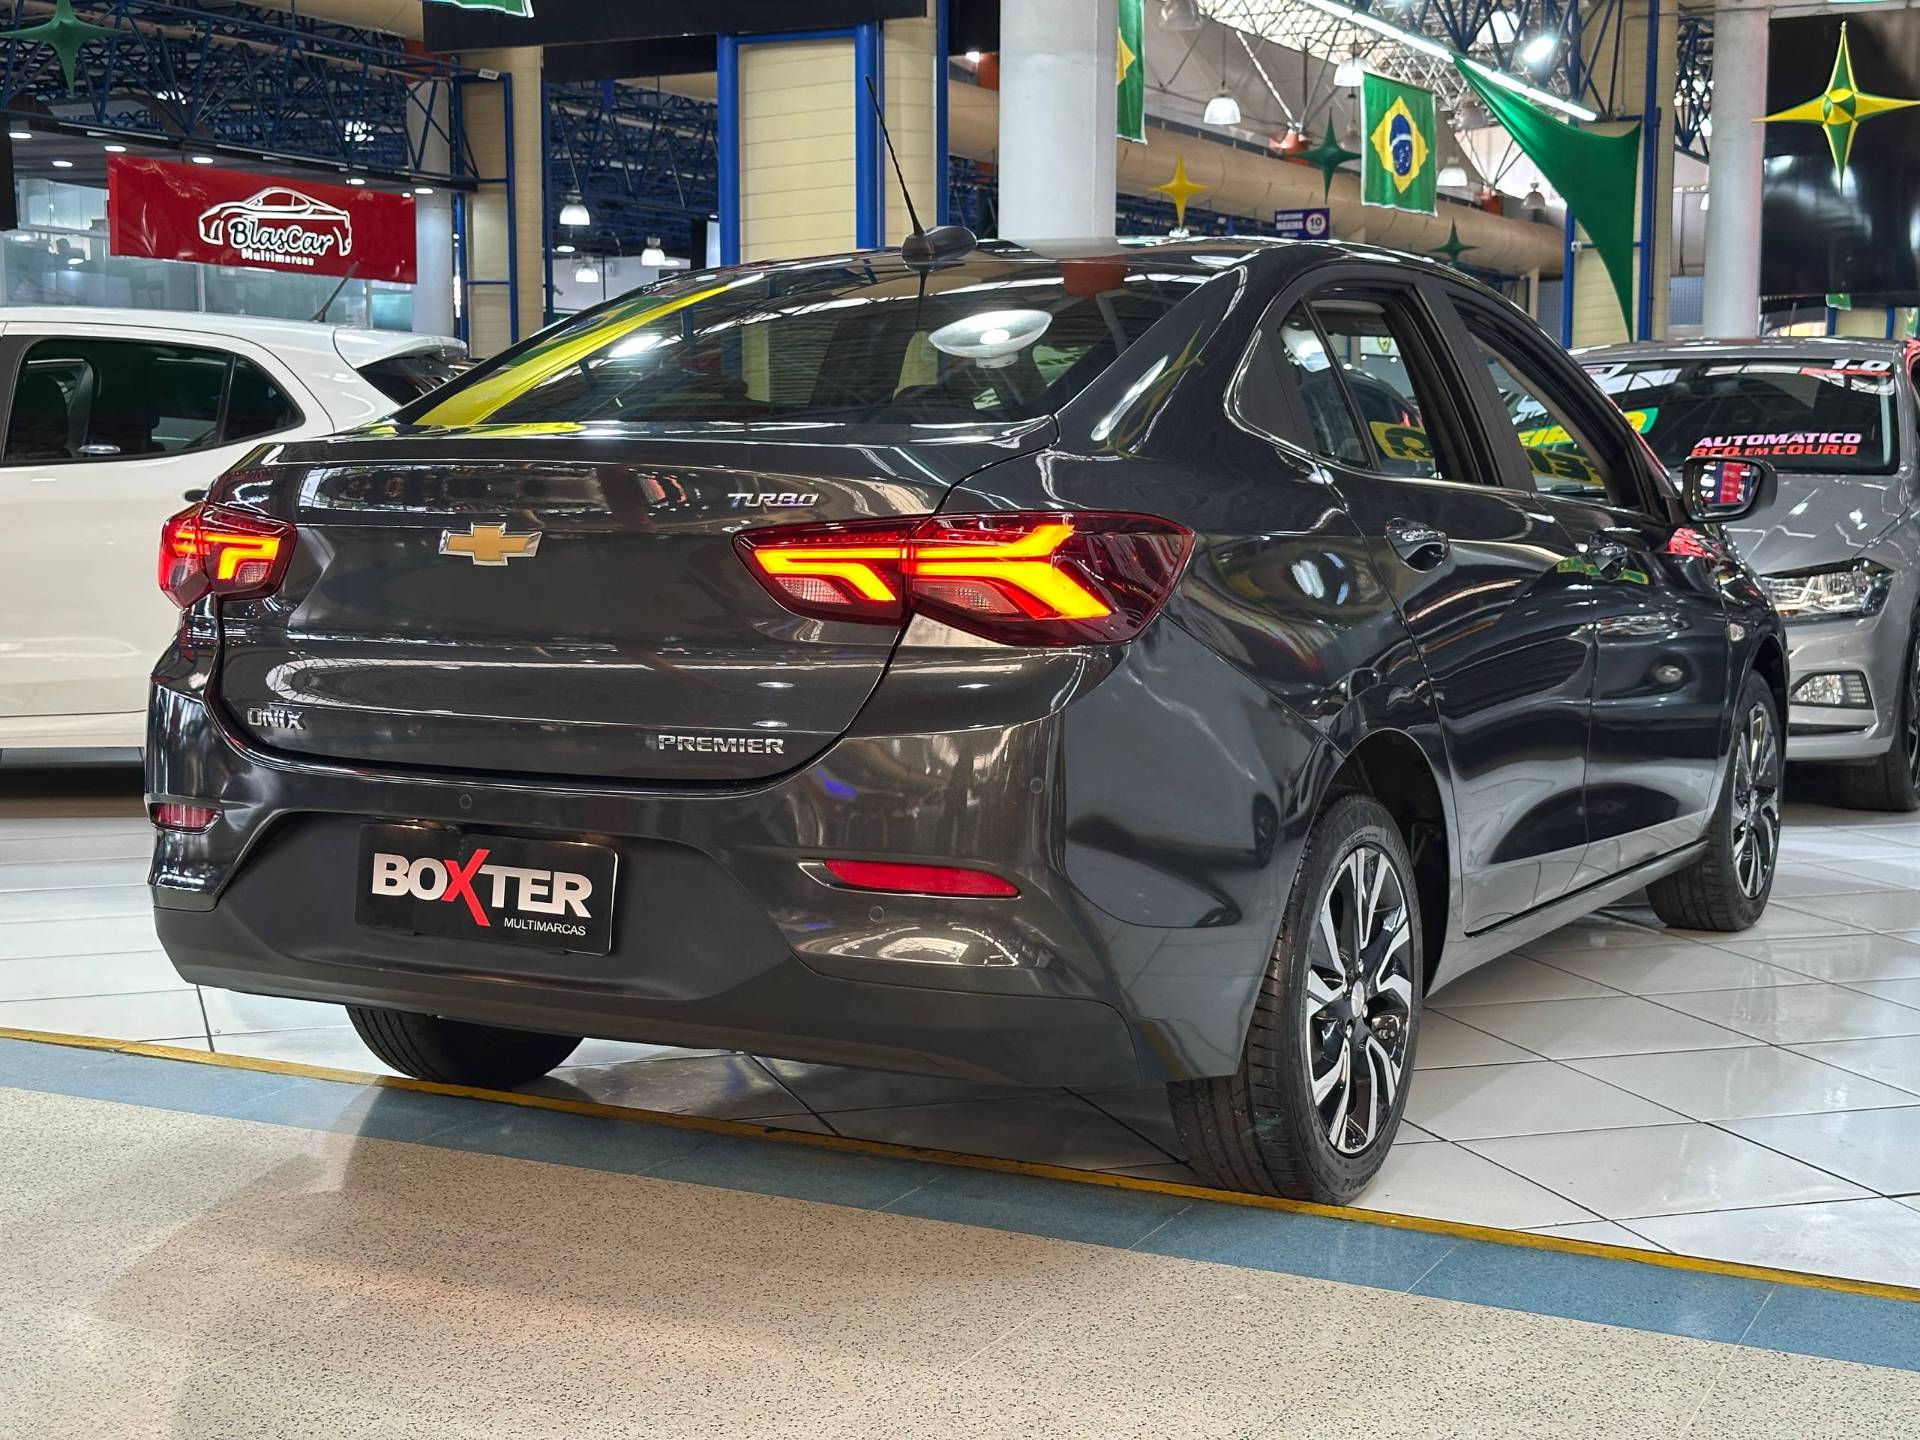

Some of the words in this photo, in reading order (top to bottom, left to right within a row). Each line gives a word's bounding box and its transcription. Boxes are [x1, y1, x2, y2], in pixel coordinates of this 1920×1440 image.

[1310, 217, 1322, 227] 10
[228, 218, 333, 255] BlasCar
[241, 248, 315, 266] Multimarcas
[1694, 432, 1862, 448] AUTOMATICO
[1744, 447, 1769, 456] EM
[1772, 444, 1859, 455] COURO
[727, 492, 819, 507] TURBO
[247, 707, 304, 729] ONIX
[658, 734, 784, 754] PREMIER
[372, 848, 593, 927] BOXTER
[504, 917, 587, 936] MULTIMARCAS
